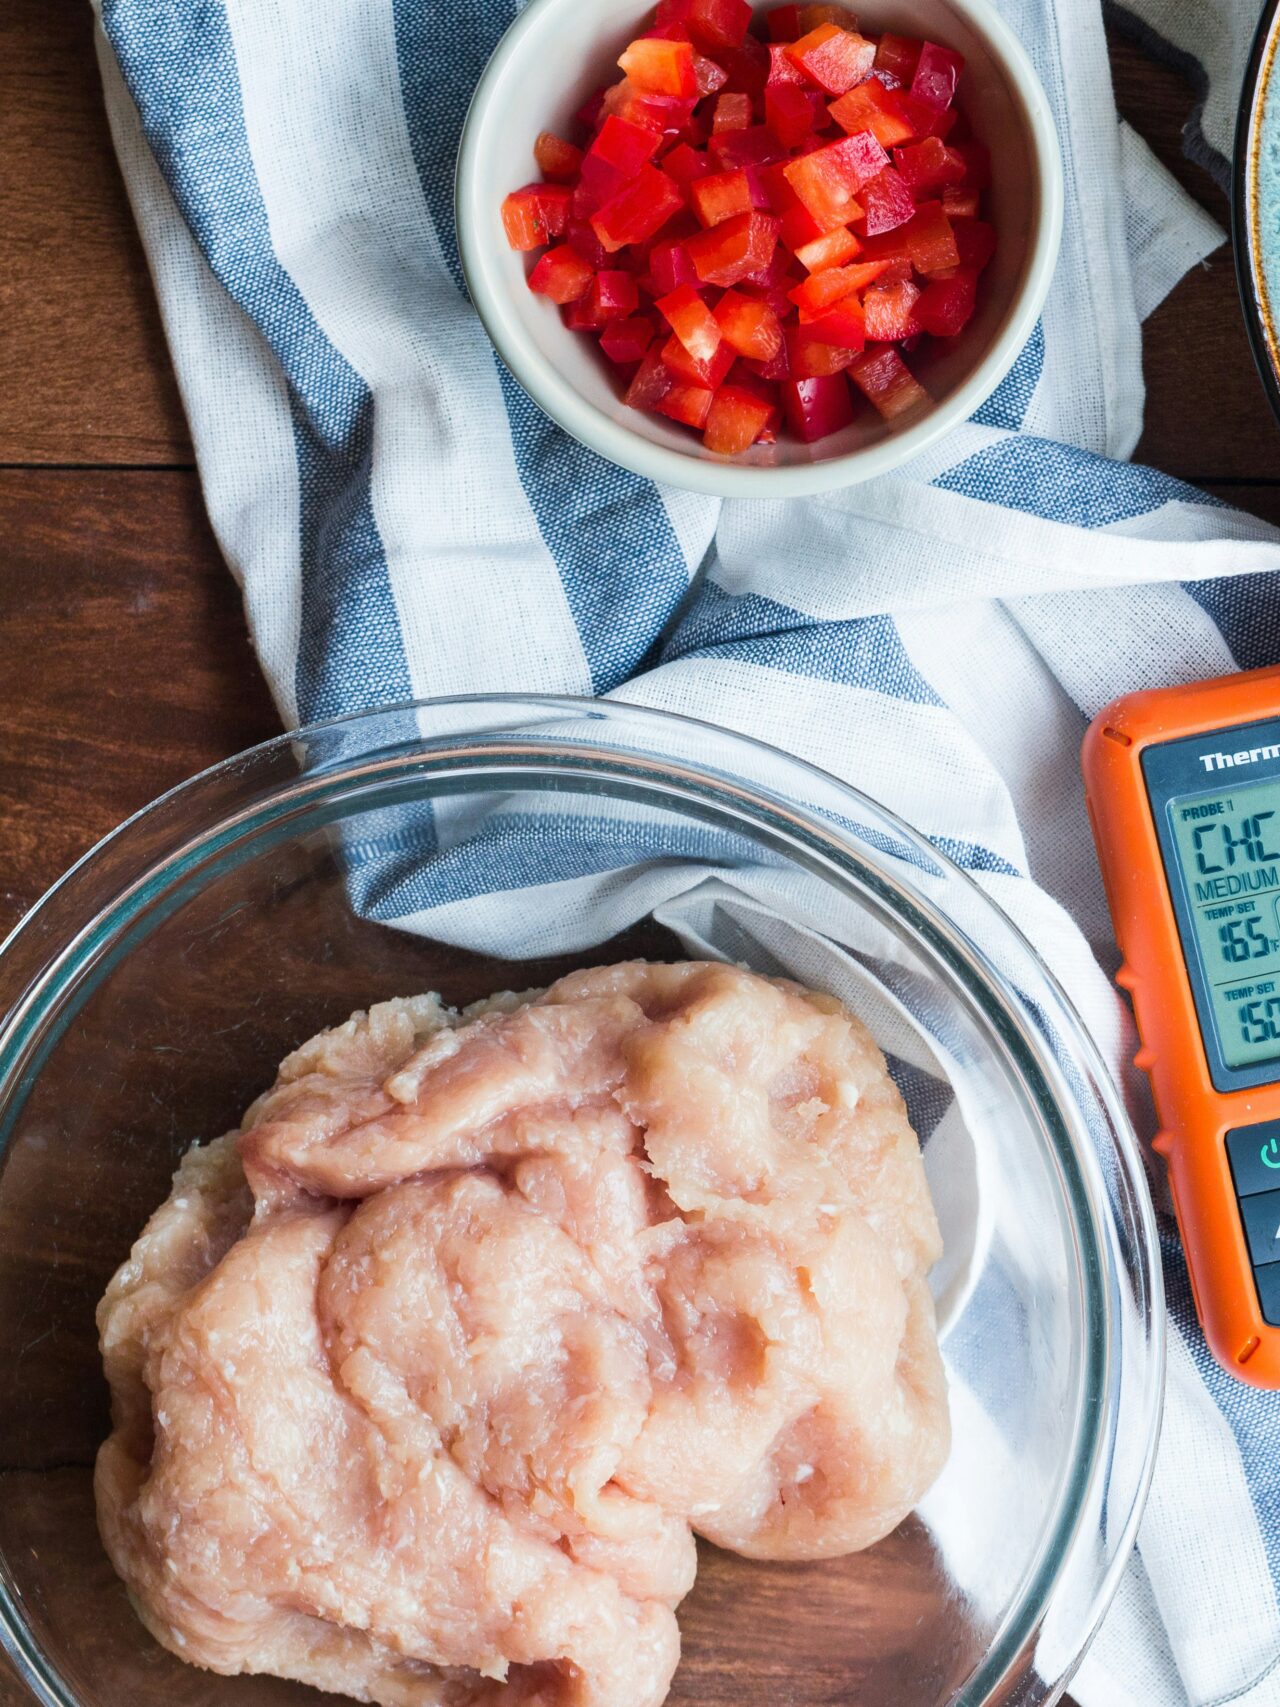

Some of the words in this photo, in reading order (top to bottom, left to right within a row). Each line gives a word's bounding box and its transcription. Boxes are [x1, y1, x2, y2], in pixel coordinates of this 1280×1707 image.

[1182, 802, 1225, 821] PROBE
[1228, 799, 1234, 812] 1
[1195, 866, 1280, 901] MEDIUM
[1204, 905, 1235, 921] TEMP
[1237, 901, 1256, 914] SET
[1224, 986, 1255, 1002] TEMP
[1257, 981, 1276, 995] SET
